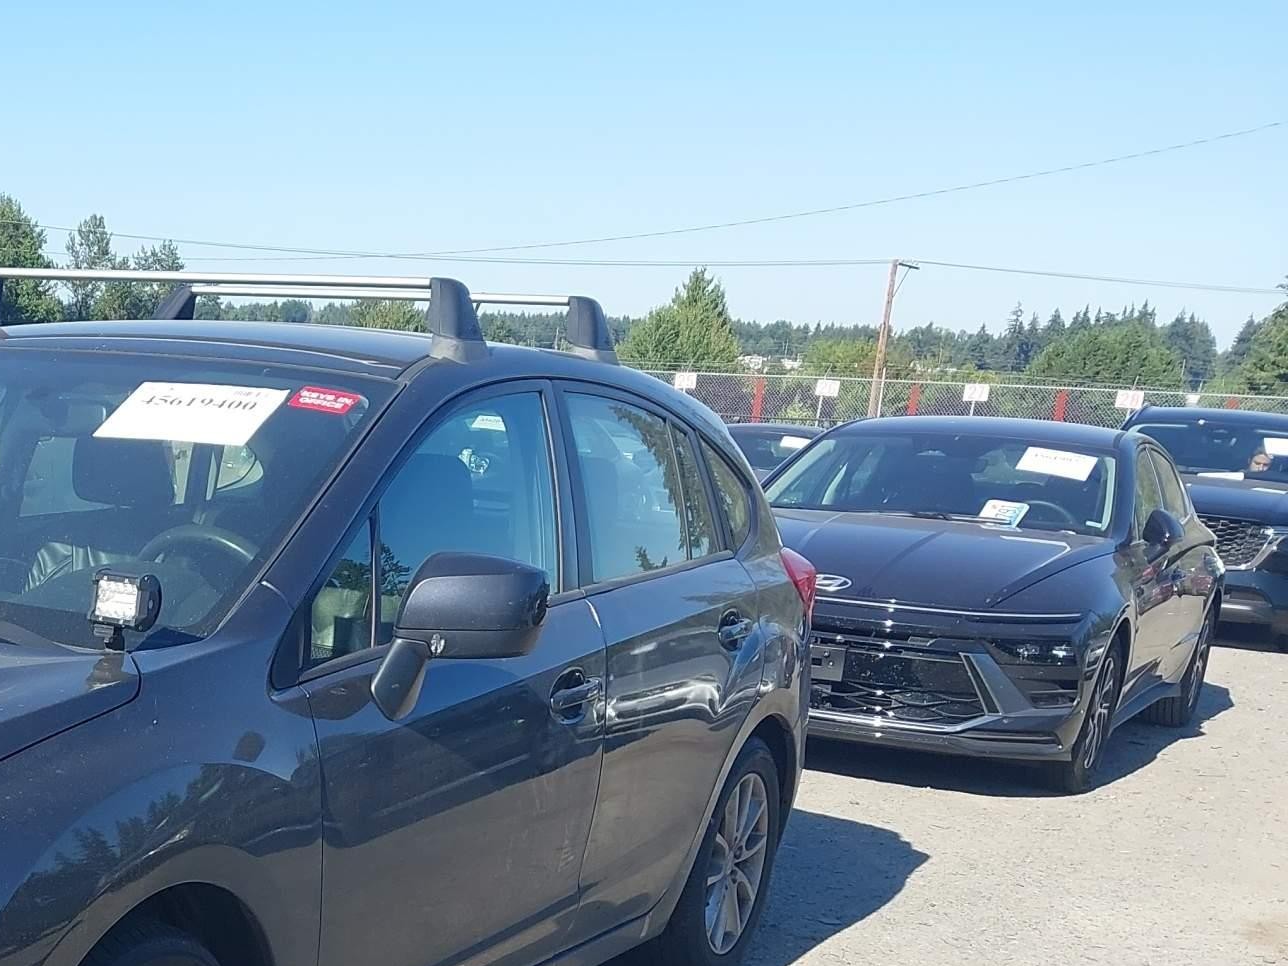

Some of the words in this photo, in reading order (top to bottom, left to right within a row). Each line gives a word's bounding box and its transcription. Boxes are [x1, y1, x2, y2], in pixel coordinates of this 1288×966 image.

[300, 390, 336, 401] KEYS
[967, 385, 985, 400] 27
[141, 395, 258, 411] 45619400
[298, 397, 345, 409] OFFICE
